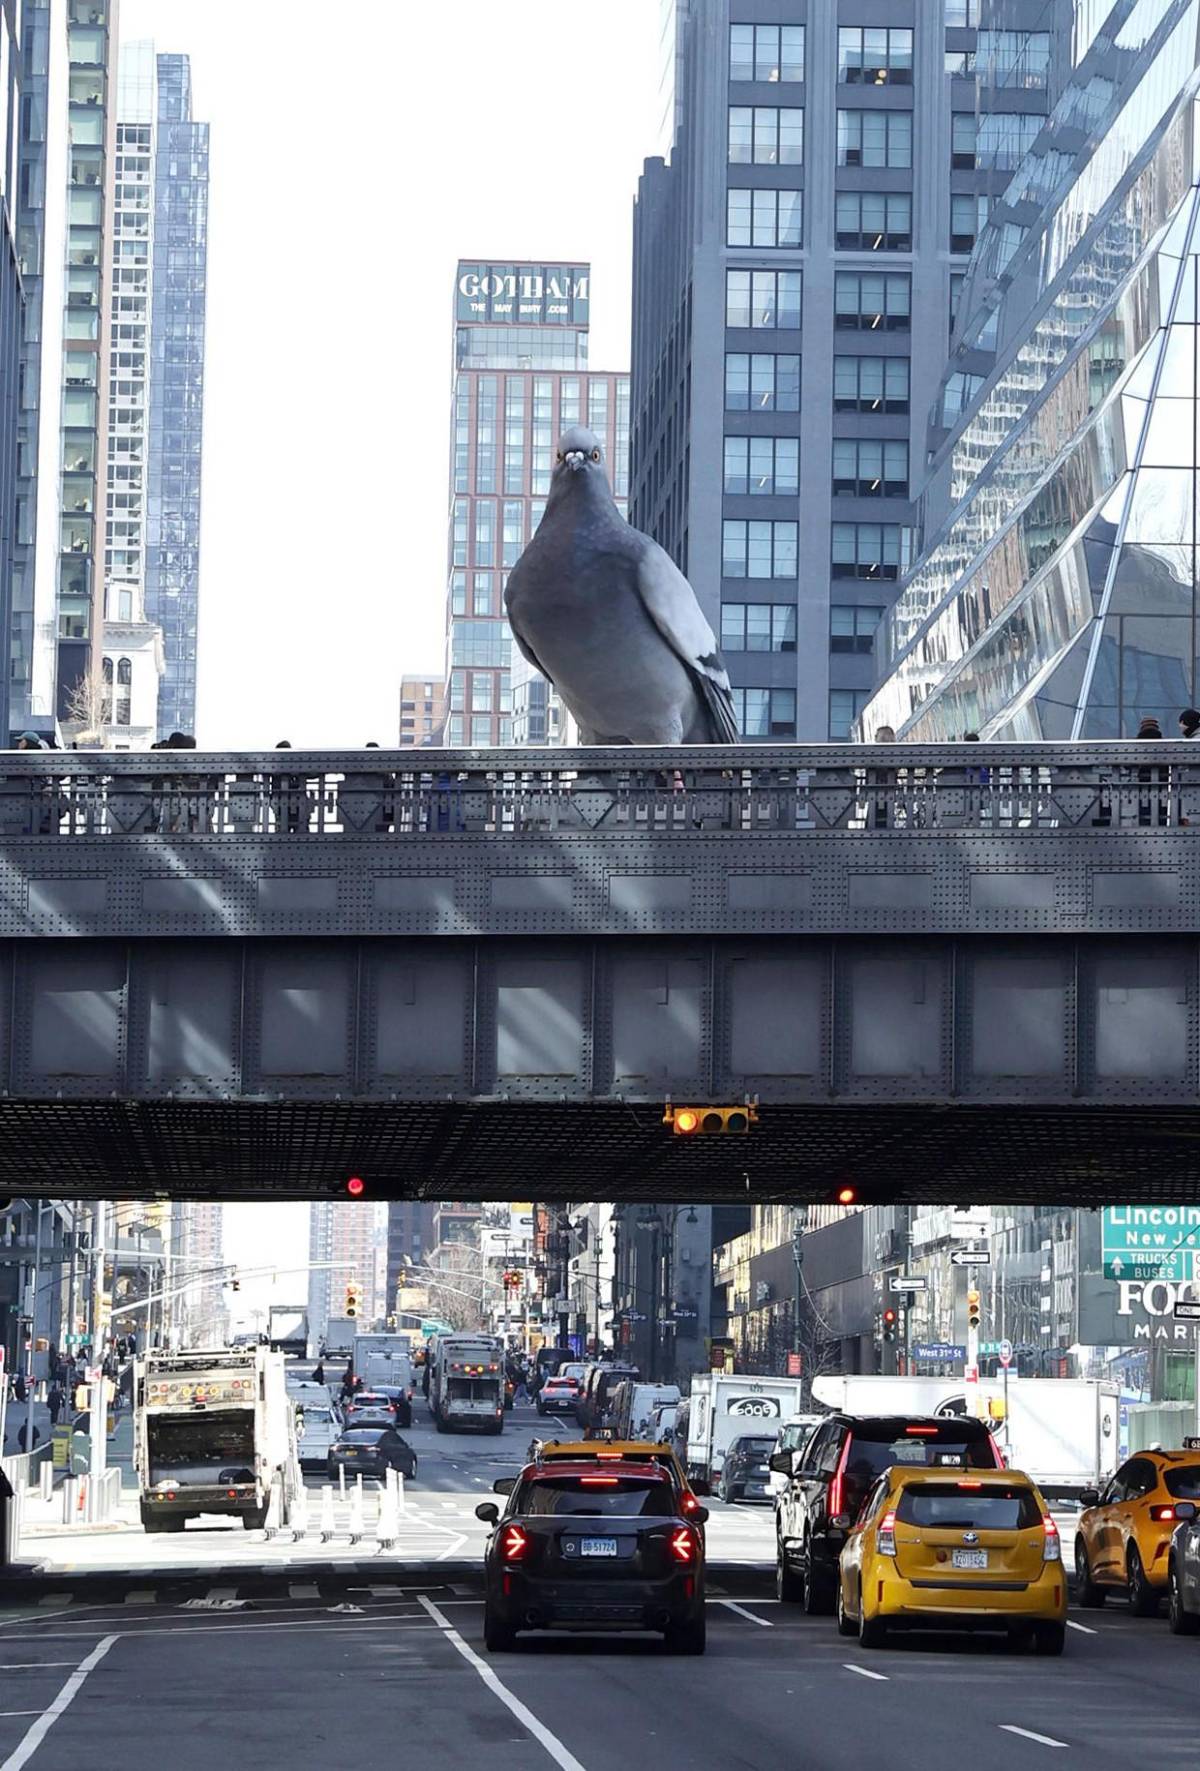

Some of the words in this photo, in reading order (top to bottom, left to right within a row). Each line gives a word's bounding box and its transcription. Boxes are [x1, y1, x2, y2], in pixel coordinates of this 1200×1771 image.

[459, 274, 589, 299] GOTHAM
[470, 303, 486, 312] THE
[1126, 1231, 1165, 1245] New
[1172, 1231, 1200, 1245] Je
[1131, 1253, 1177, 1264] TRUCKS
[1134, 1268, 1174, 1278] BUSES
[919, 1348, 938, 1357] West
[953, 1348, 962, 1358] St
